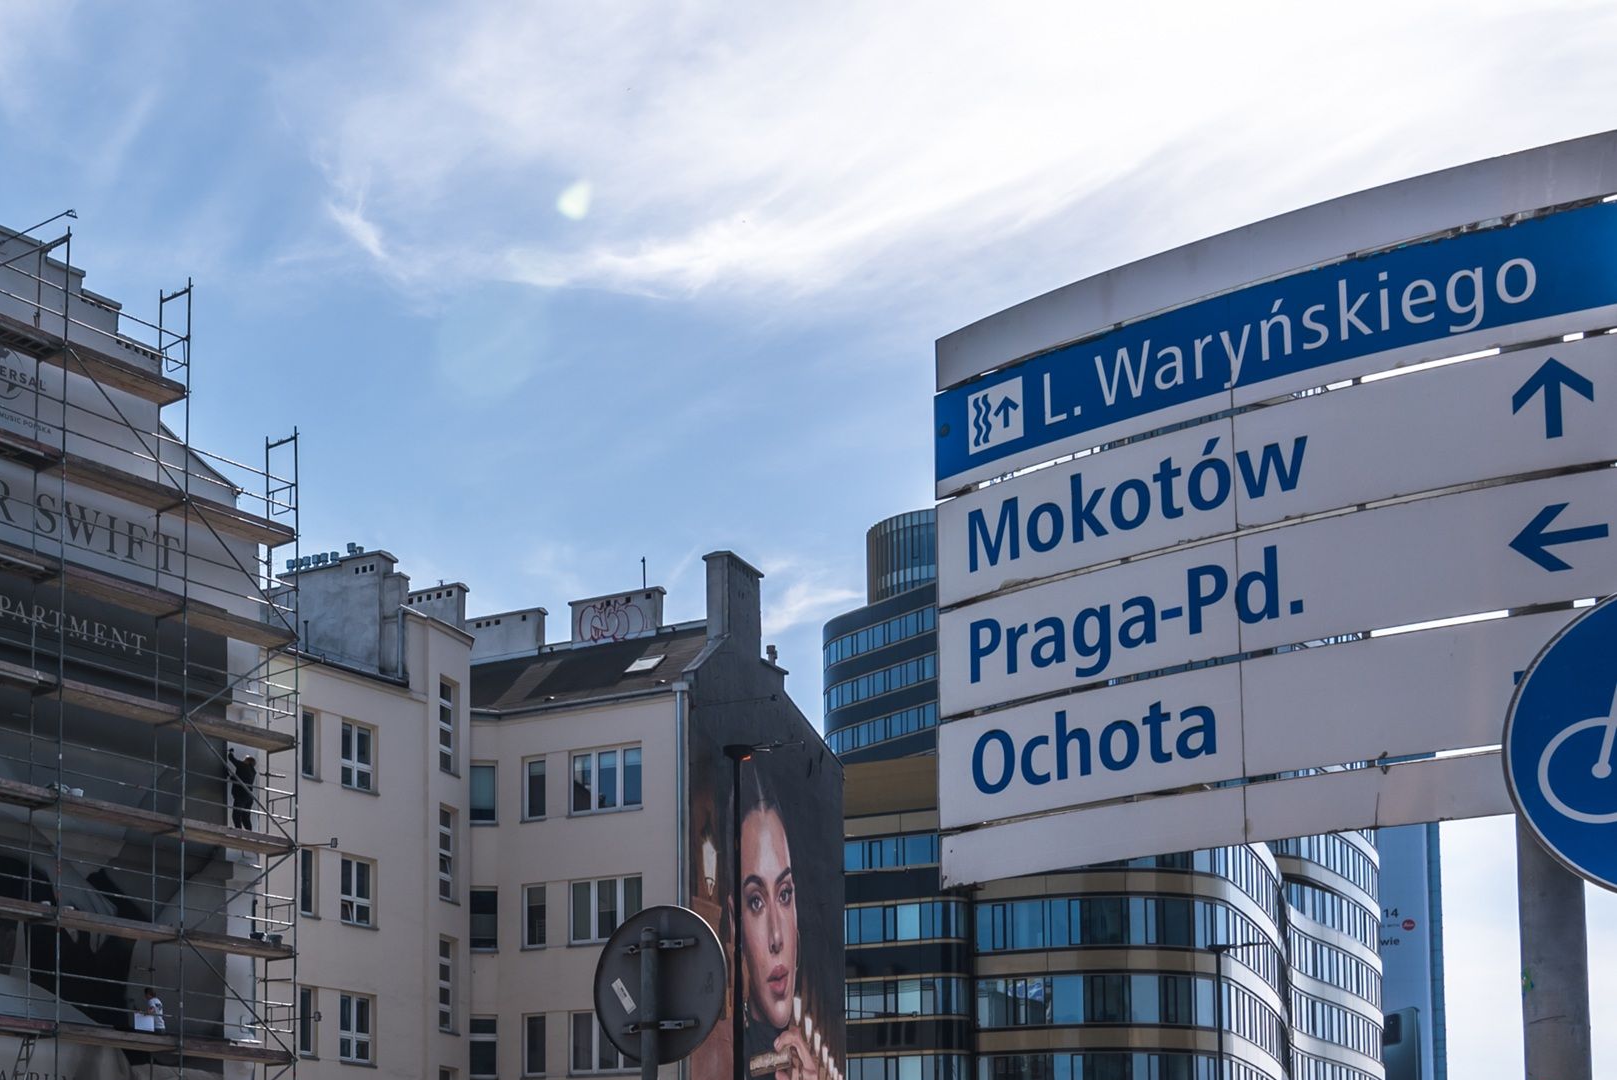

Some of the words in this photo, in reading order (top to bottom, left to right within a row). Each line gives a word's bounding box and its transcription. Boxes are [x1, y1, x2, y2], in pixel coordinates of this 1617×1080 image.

[1041, 371, 1083, 426] L.
[1093, 256, 1538, 406] Waryńskiego
[34, 492, 181, 574] SWIFT
[966, 434, 1310, 574] Mokotów
[968, 545, 1306, 685] Praga-Pd.
[970, 700, 1219, 797] Ochota
[1383, 907, 1399, 918] 14
